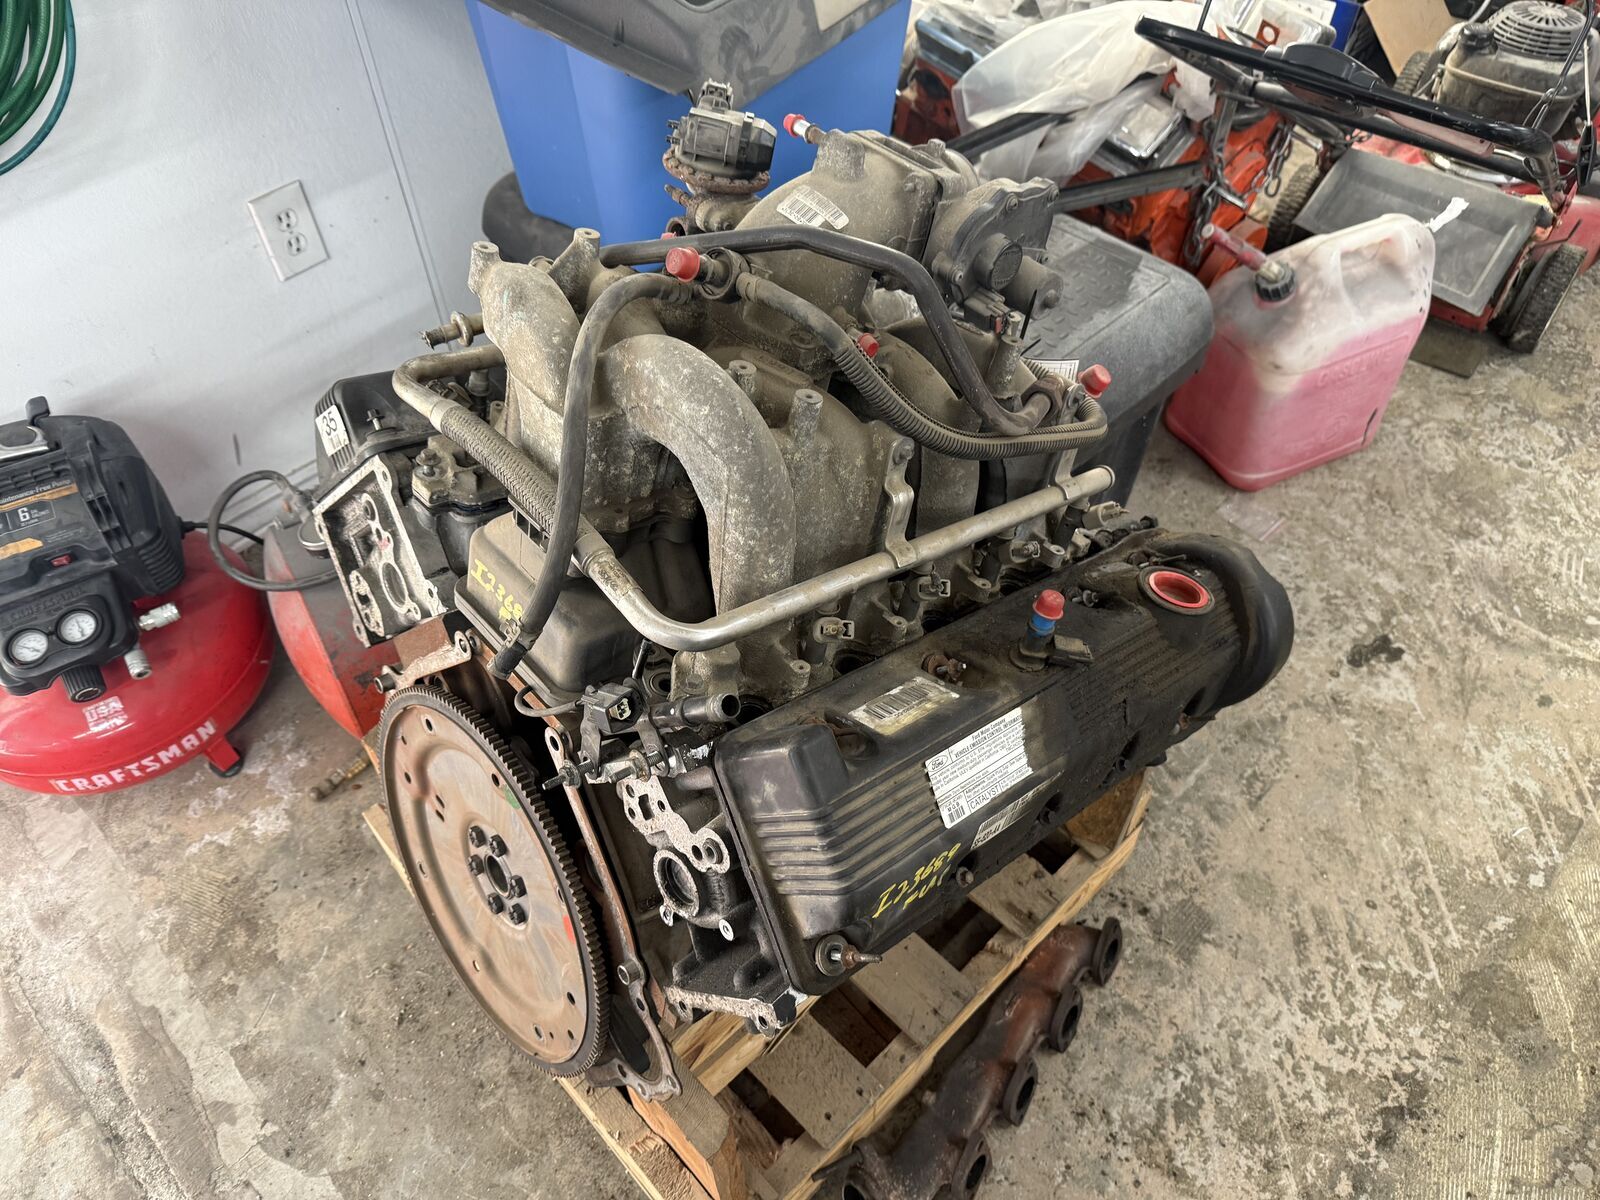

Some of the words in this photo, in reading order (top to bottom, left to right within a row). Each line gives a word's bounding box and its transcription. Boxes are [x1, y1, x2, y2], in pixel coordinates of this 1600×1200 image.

[322, 411, 338, 436] 35
[17, 507, 31, 522] 6
[86, 700, 124, 722] USA
[971, 731, 980, 740] Ford
[980, 726, 990, 735] Motor
[990, 717, 1005, 729] Company
[954, 746, 969, 758] VEHICLE
[969, 735, 986, 749] EMISSION
[986, 725, 1002, 739] CONTROL
[54, 720, 216, 792] CRAFTSMAN
[930, 756, 944, 770] Ford
[969, 784, 999, 810] CATALYST
